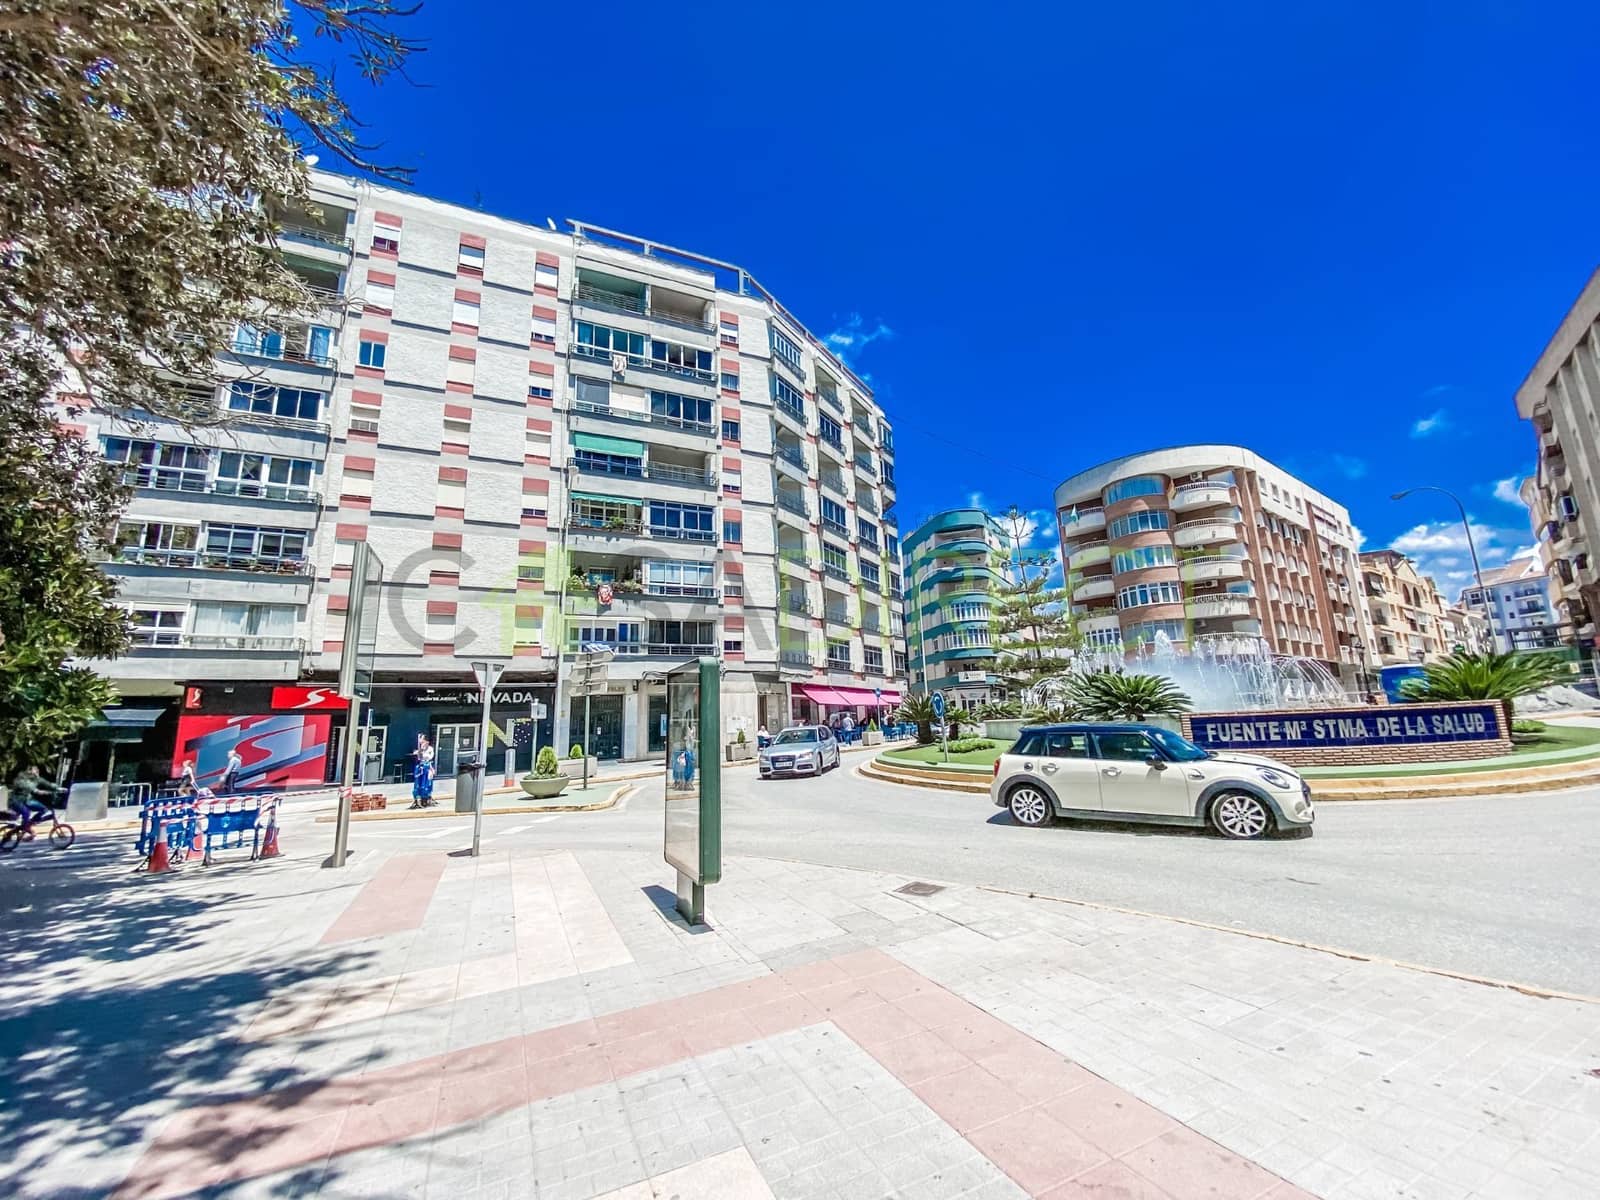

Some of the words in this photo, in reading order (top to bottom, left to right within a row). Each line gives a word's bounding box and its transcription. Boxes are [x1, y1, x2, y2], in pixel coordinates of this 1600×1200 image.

[1207, 722, 1281, 742] FUENTE
[1377, 715, 1399, 736] DE
[1405, 714, 1427, 735] LA
[1433, 713, 1485, 733] SALUD
